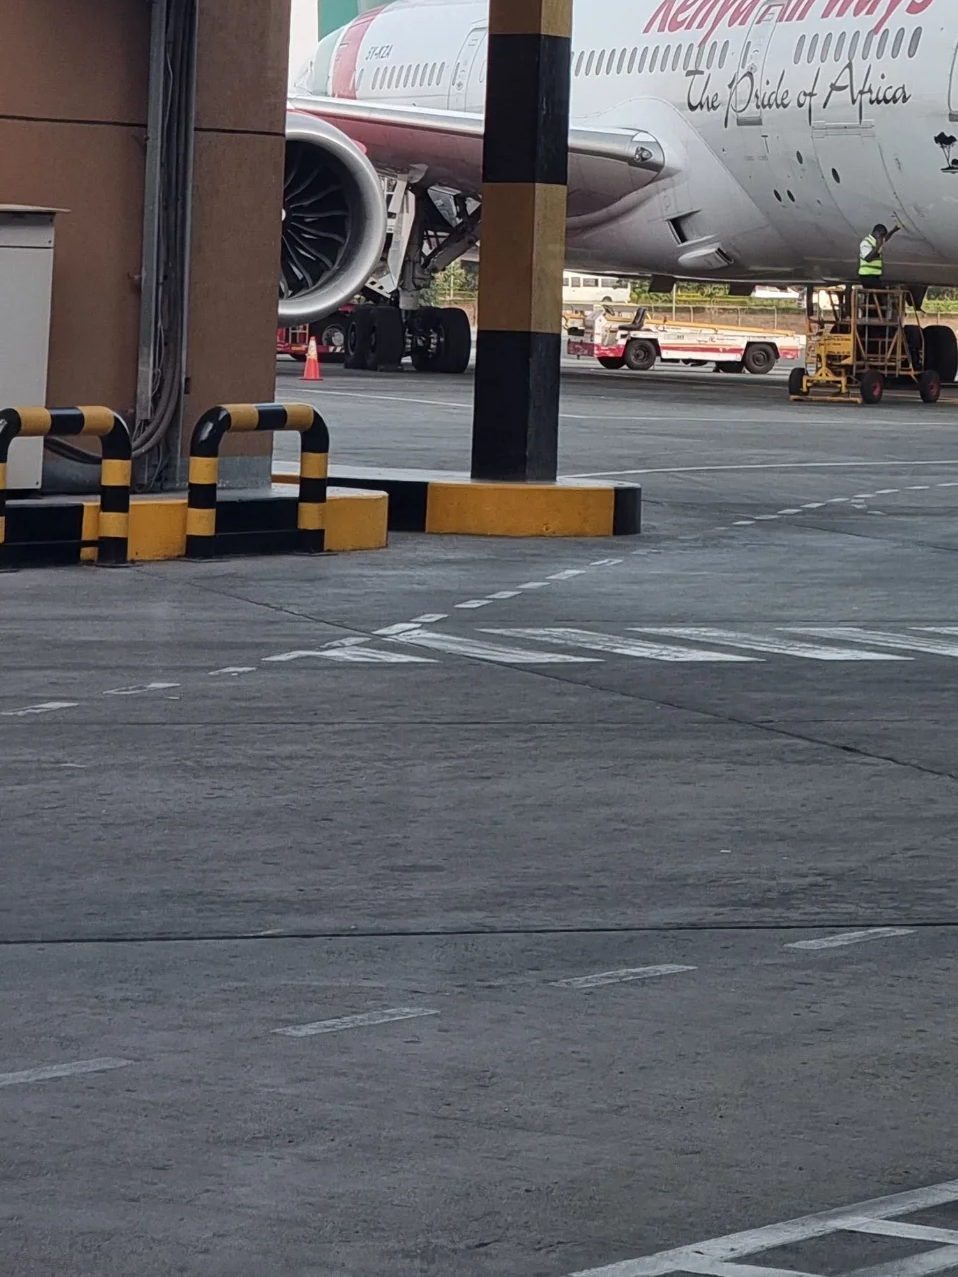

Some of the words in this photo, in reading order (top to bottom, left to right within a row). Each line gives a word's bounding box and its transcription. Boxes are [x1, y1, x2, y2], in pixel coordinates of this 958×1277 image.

[685, 69, 721, 112] The
[724, 69, 791, 128] Pride
[796, 67, 820, 126] of
[823, 60, 912, 125] Africa
